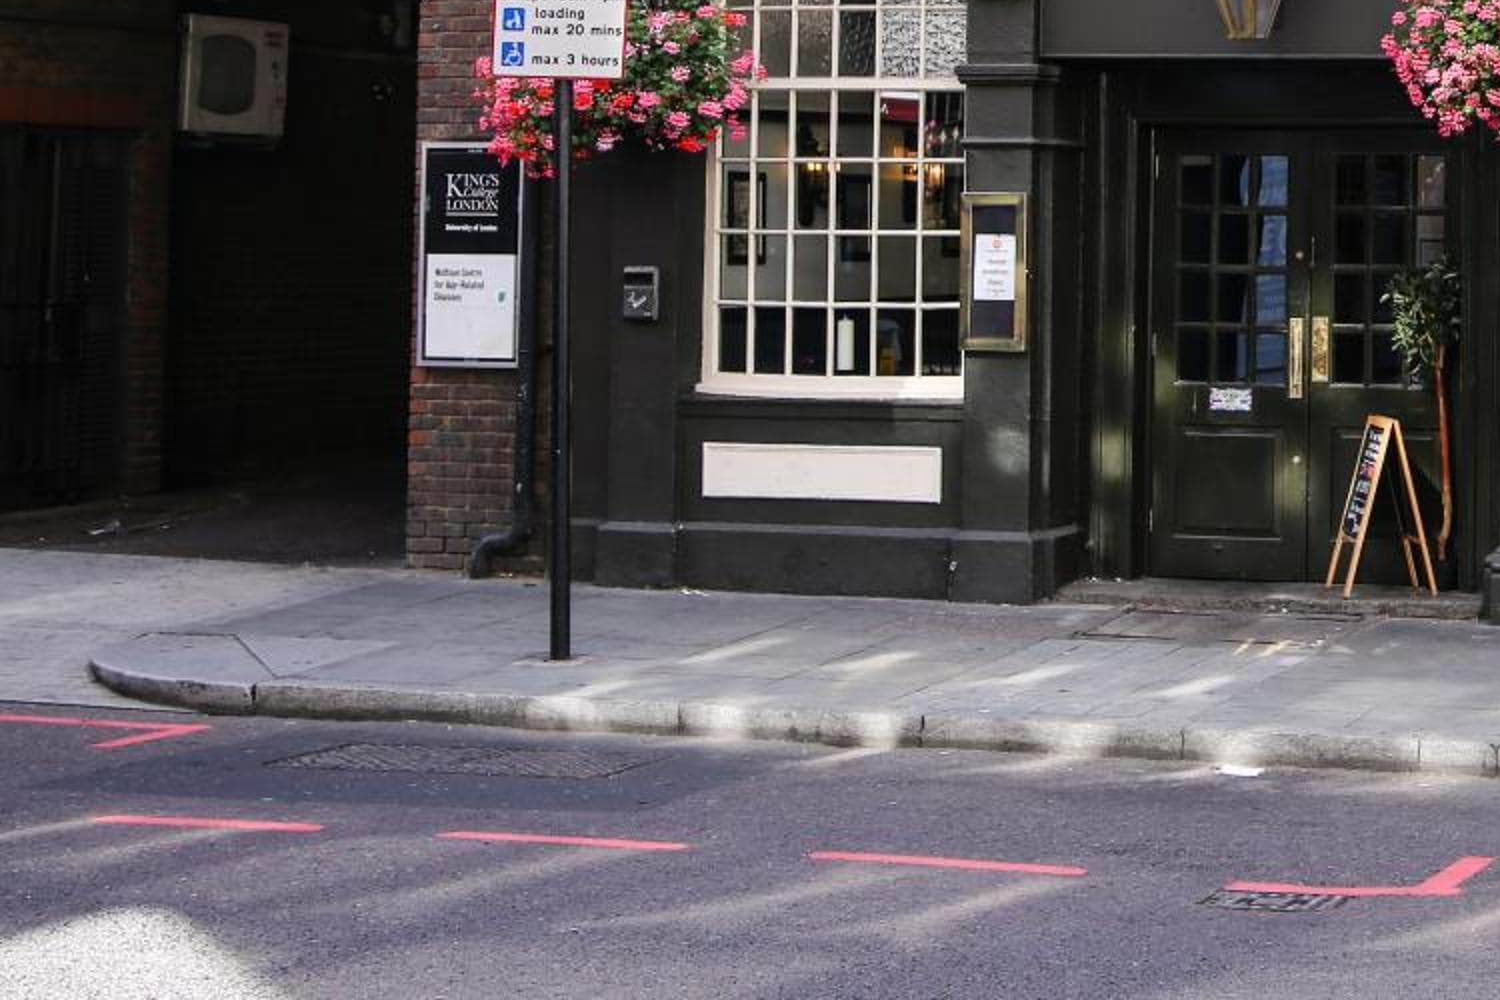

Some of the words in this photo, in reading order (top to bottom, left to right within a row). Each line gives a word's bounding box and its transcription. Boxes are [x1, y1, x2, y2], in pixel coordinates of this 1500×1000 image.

[535, 7, 585, 21] loading
[531, 26, 558, 36] max
[566, 24, 585, 36] 20
[590, 26, 622, 36] mins
[531, 55, 558, 65] max
[567, 53, 575, 65] 3
[581, 54, 619, 67] hours
[447, 199, 499, 211] LONDON
